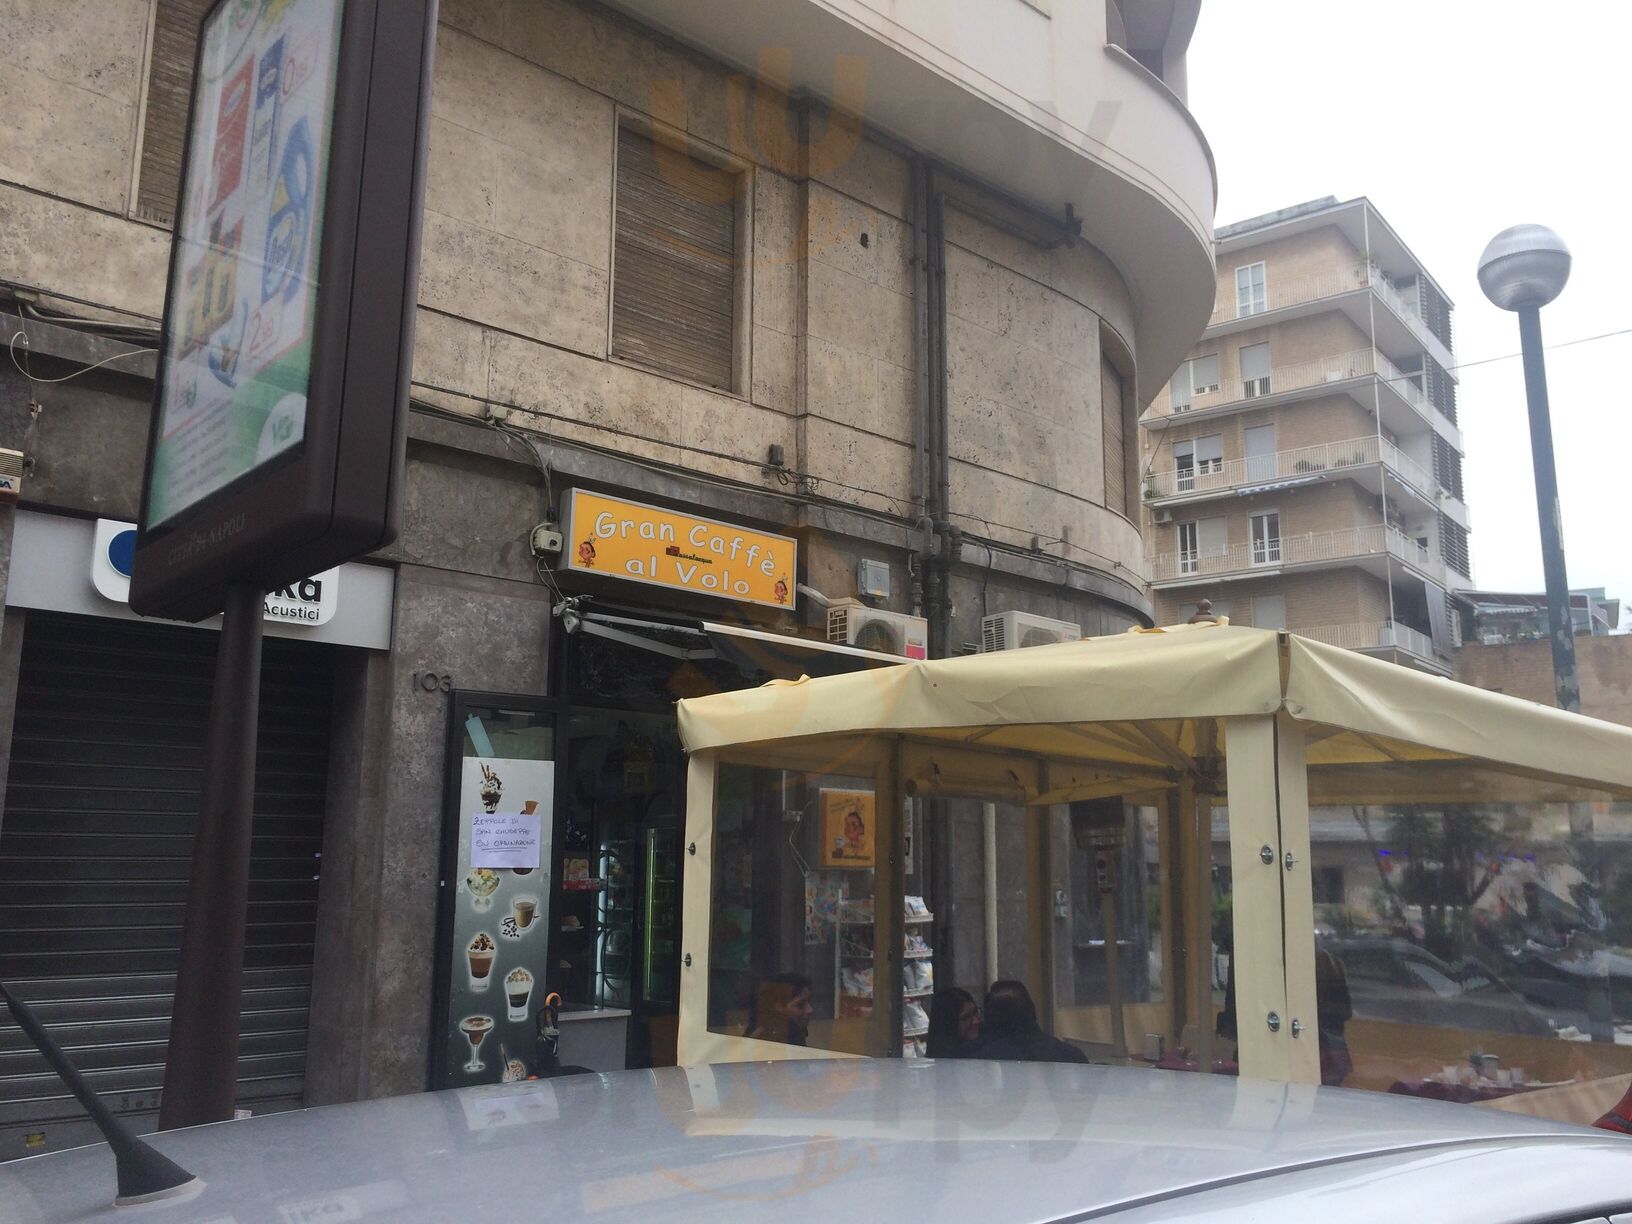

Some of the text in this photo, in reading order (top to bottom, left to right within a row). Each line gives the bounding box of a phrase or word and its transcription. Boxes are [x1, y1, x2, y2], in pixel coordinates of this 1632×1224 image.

[594, 511, 776, 578] Gran Caffè
[624, 555, 750, 595] al Volo
[264, 601, 320, 620] Acustici
[412, 672, 451, 693] 103
